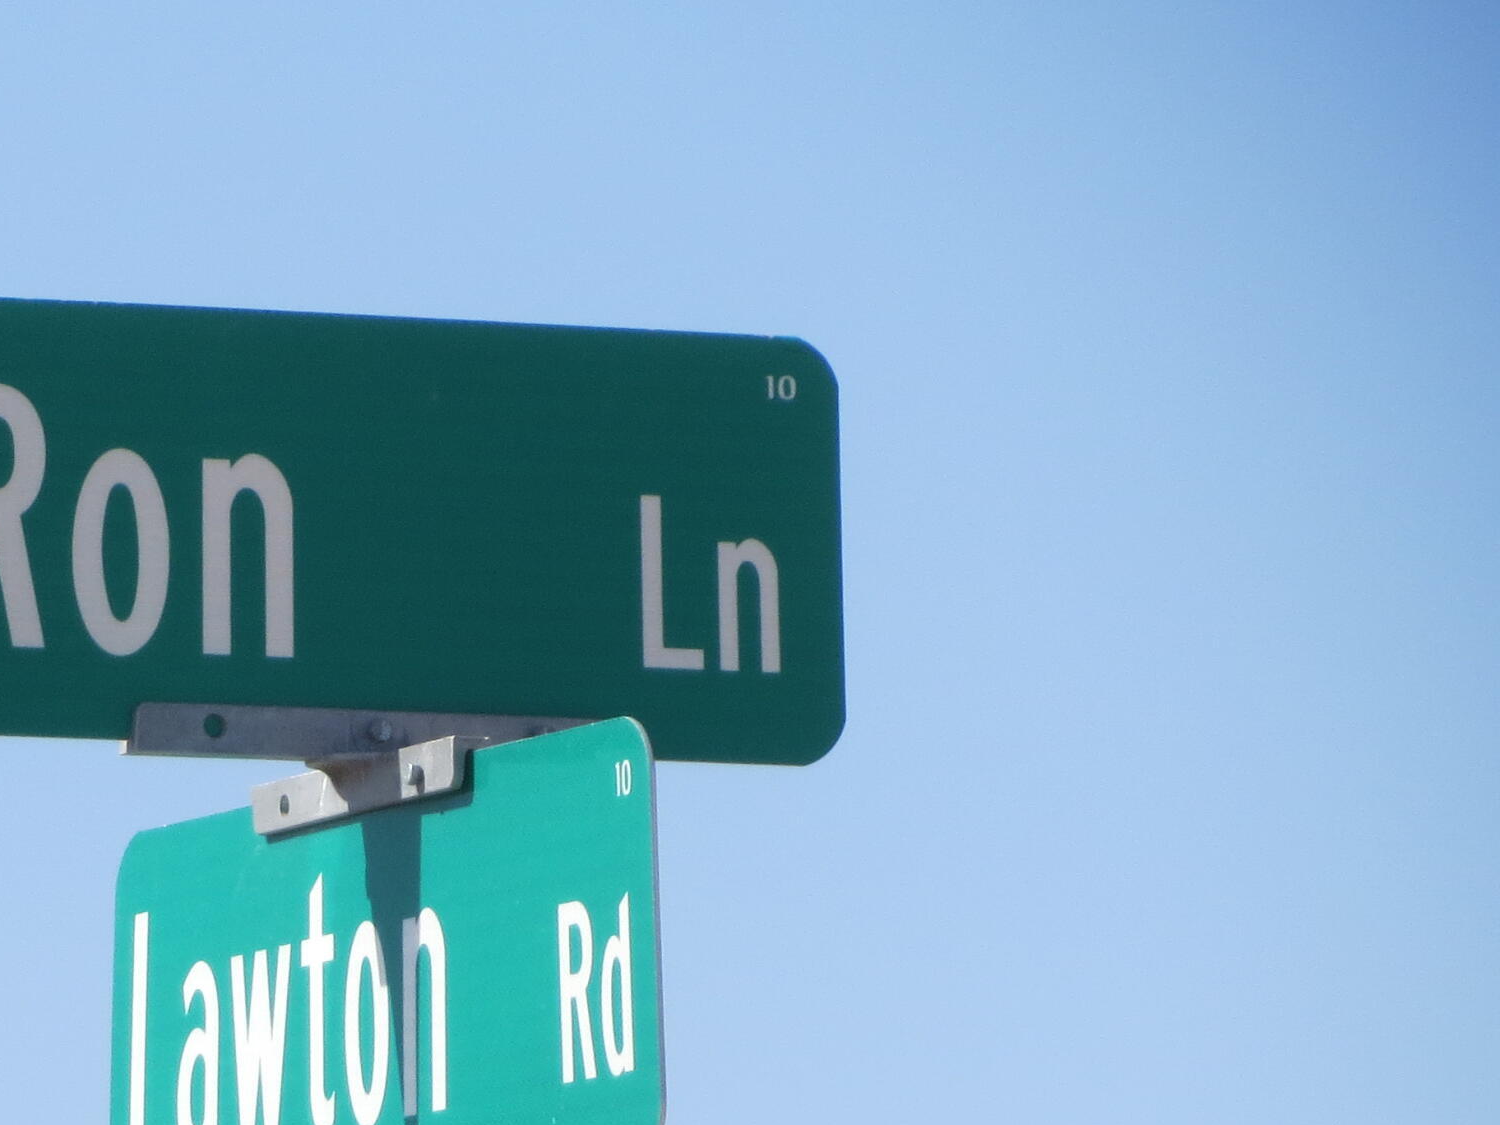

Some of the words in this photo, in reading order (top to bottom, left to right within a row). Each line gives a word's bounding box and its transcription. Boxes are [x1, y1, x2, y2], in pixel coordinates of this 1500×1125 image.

[764, 374, 797, 400] 10
[639, 494, 782, 675] Ln
[614, 759, 632, 797] 10
[556, 891, 636, 1084] Rd
